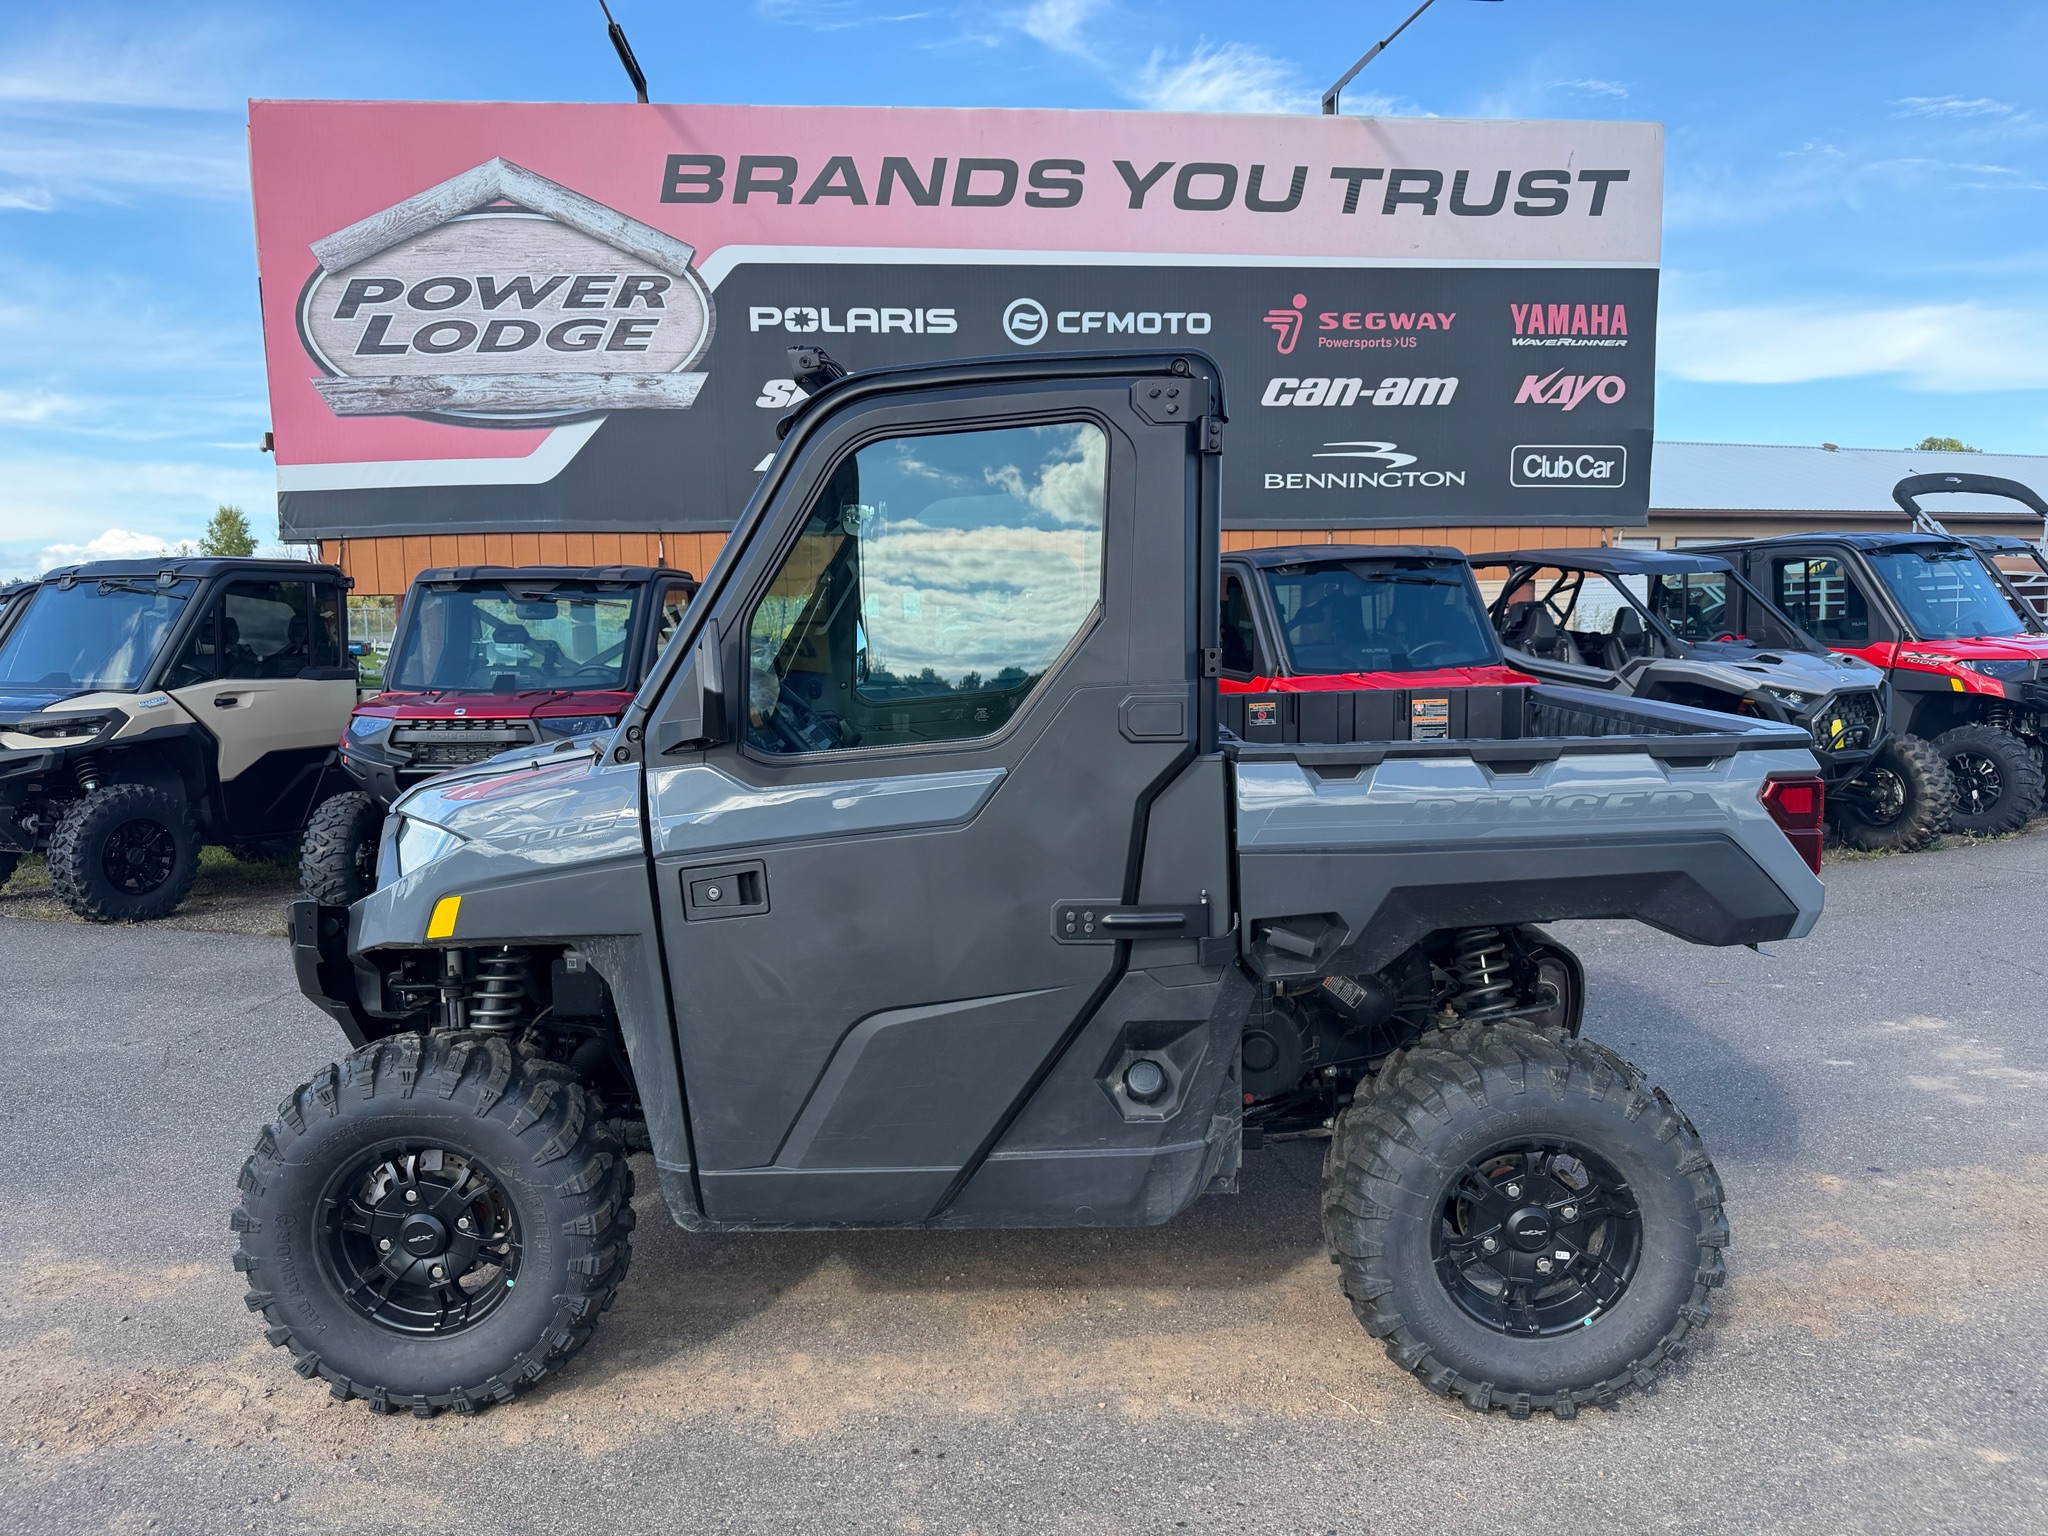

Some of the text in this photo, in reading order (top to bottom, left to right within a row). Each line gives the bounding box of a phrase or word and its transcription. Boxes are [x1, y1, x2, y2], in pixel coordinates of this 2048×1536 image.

[659, 153, 1631, 217] BRANDS YOU TRUST
[332, 273, 673, 320] POWER
[749, 306, 958, 334] POLARIS
[1057, 311, 1212, 335] CFMOTO
[1318, 312, 1457, 330] SEGWAY
[1510, 303, 1628, 335] YAMAHA
[353, 313, 662, 357] LODGE
[1511, 337, 1628, 347] WAVERUNNER
[1261, 377, 1459, 406] can-am
[1514, 367, 1626, 411] KAYO
[1263, 470, 1466, 489] BENNINGTON
[1522, 454, 1615, 478] Club Car
[427, 732, 490, 742] POLARIS
[1401, 789, 1695, 824] RANGER
